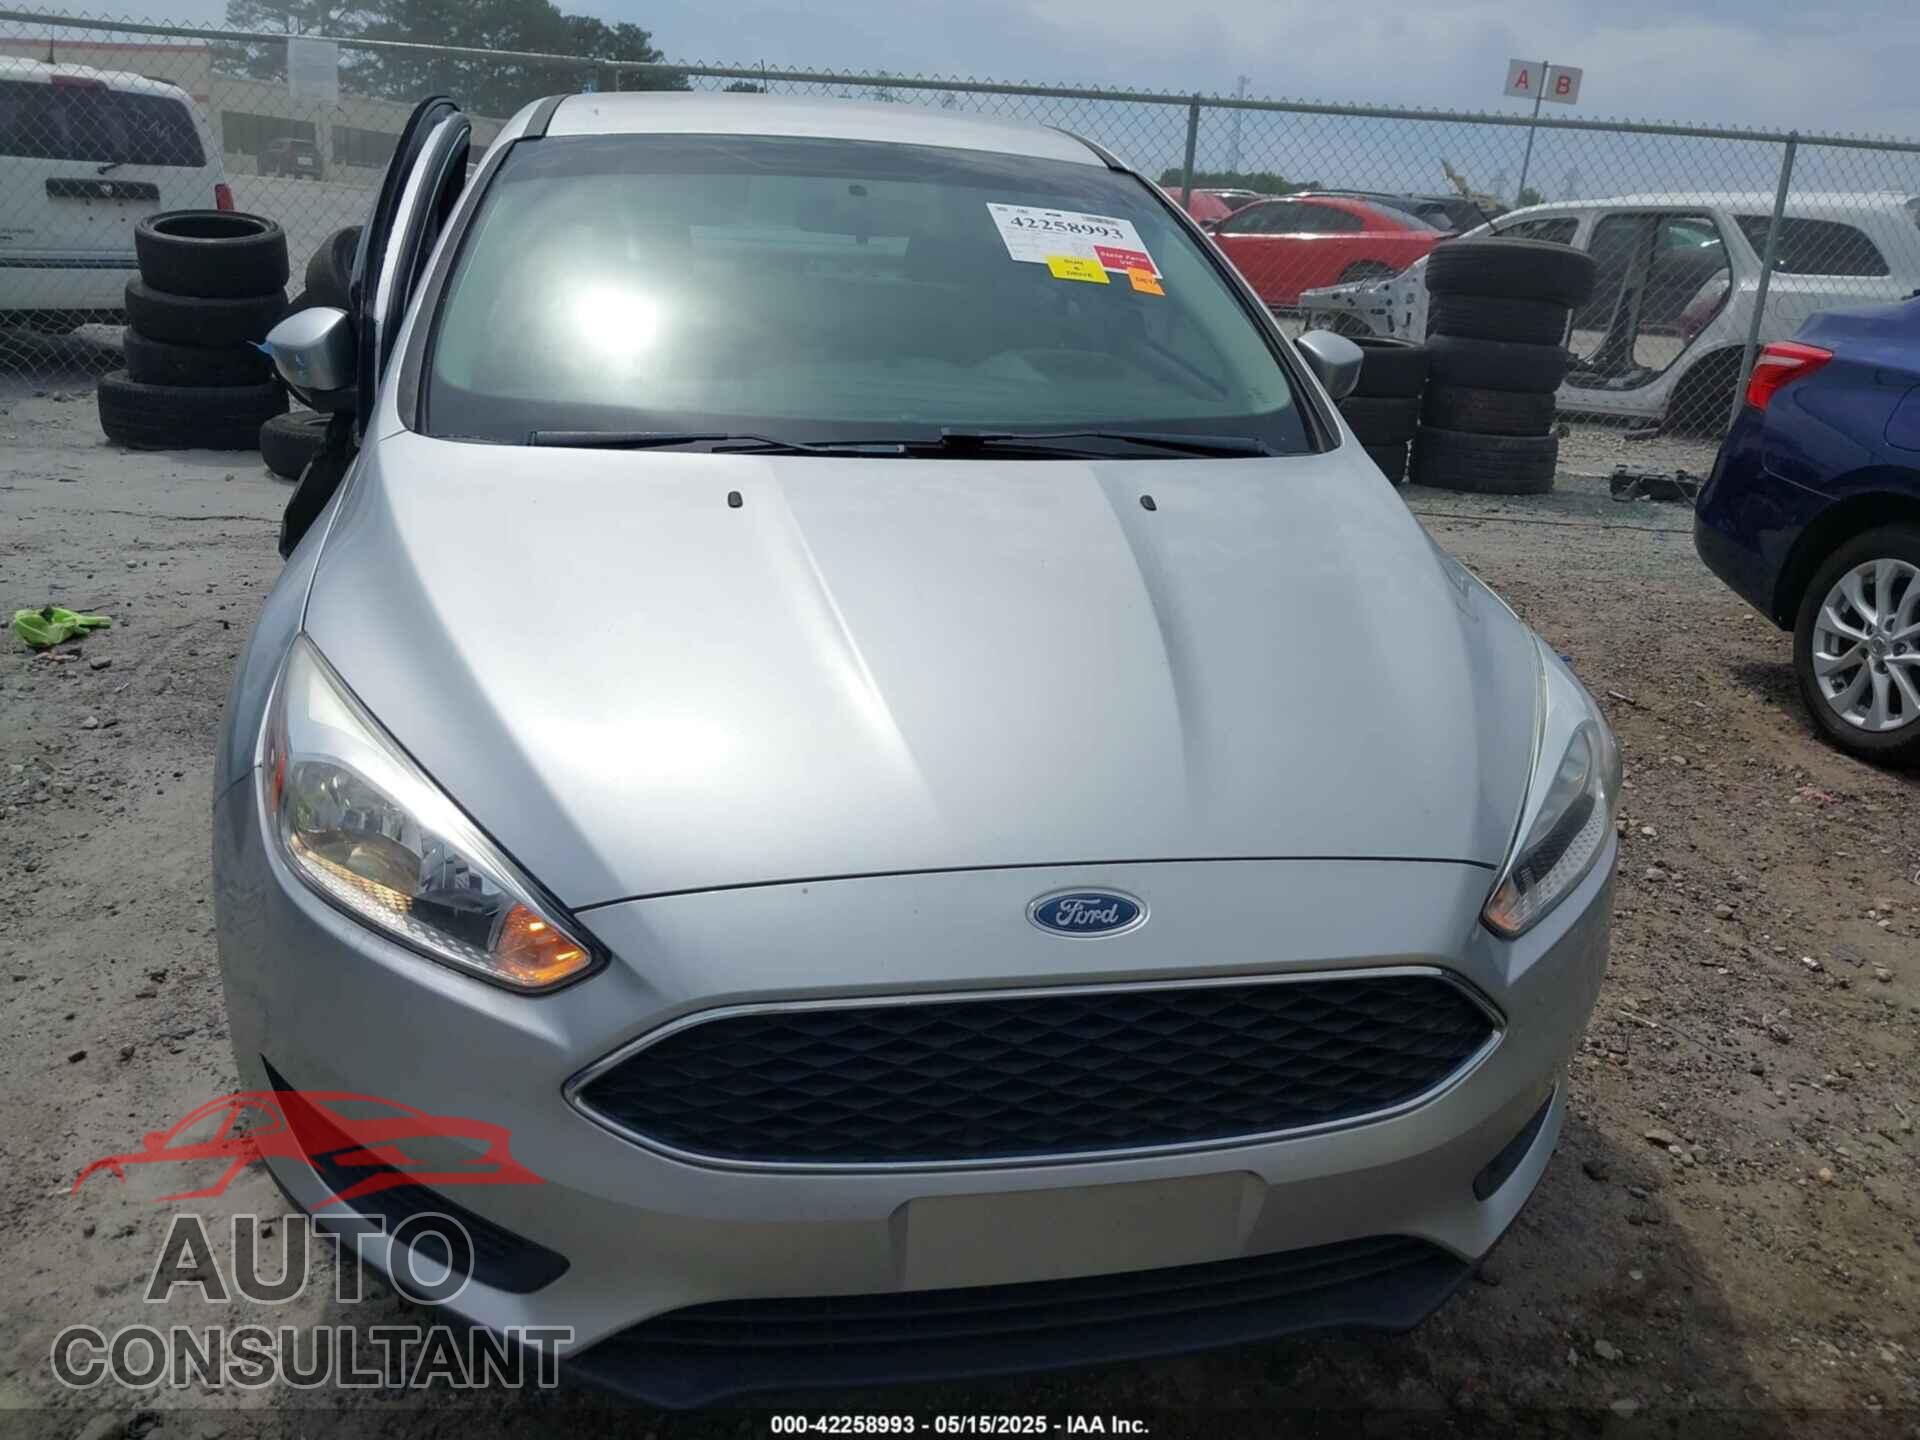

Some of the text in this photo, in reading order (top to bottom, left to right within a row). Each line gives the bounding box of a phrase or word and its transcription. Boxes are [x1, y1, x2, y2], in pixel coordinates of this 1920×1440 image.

[1514, 69, 1528, 89] A
[1556, 75, 1571, 95] B
[1010, 216, 1124, 239] 42258993
[1055, 898, 1120, 926] Ford
